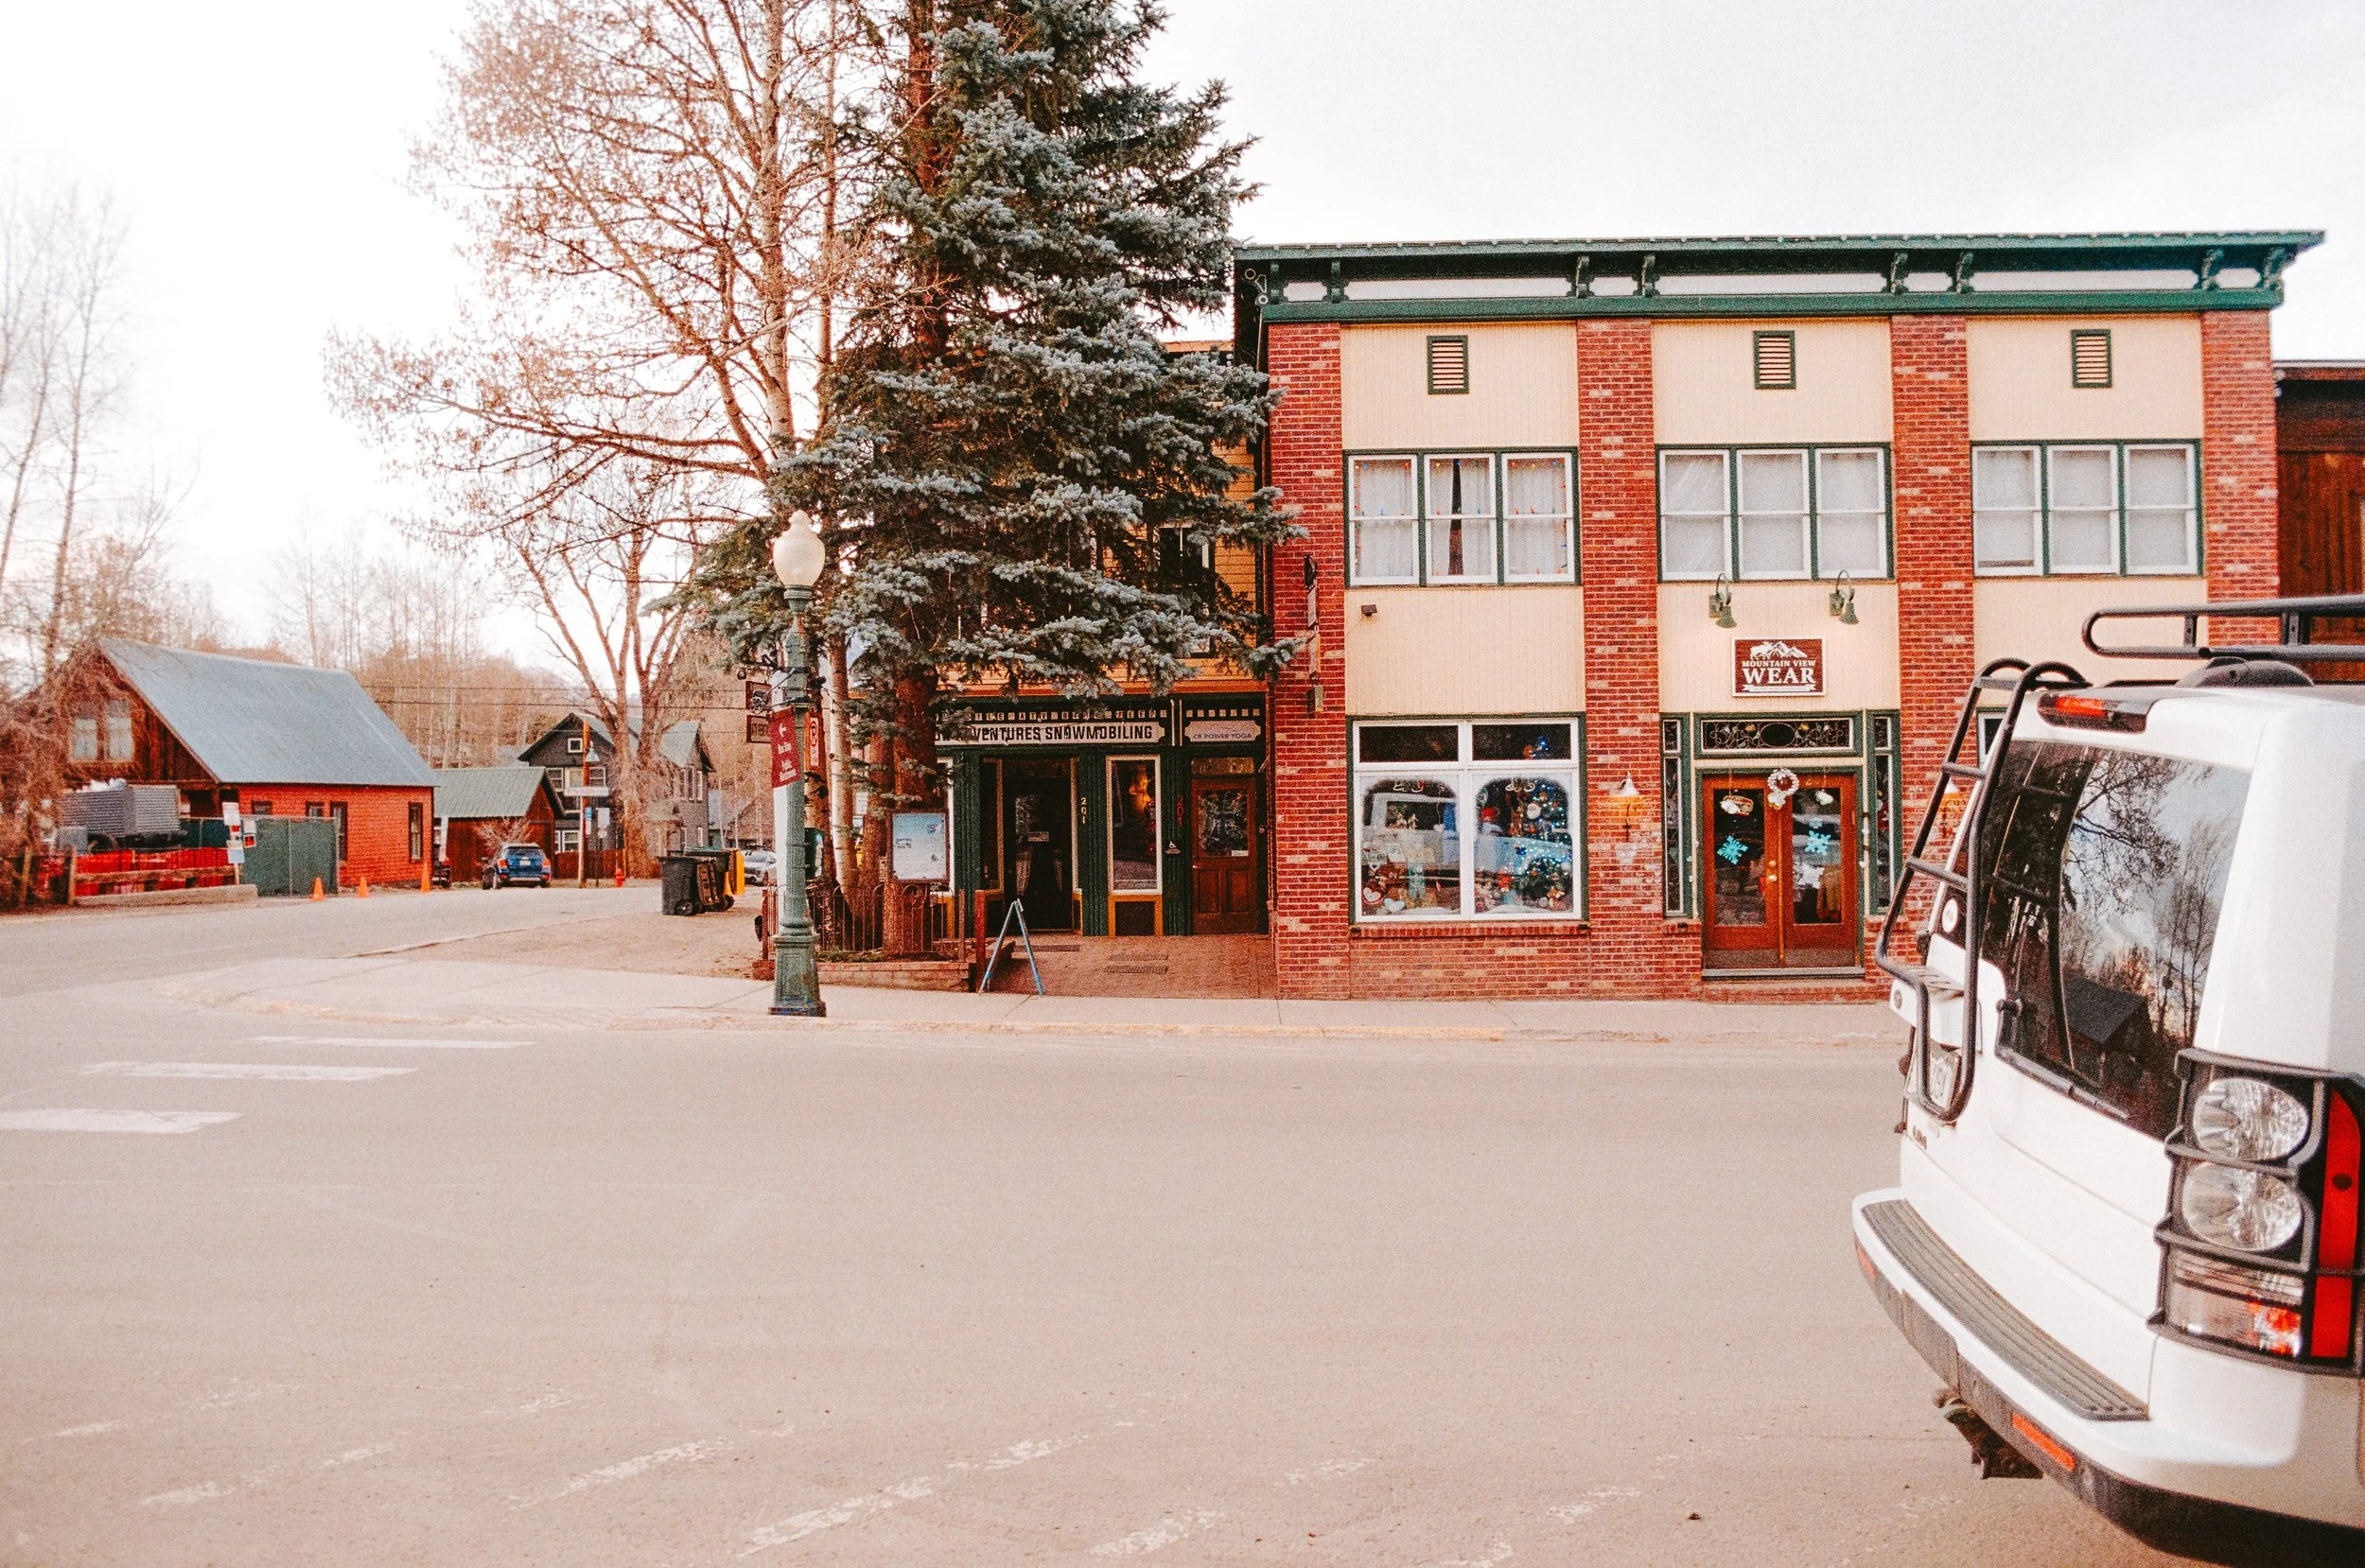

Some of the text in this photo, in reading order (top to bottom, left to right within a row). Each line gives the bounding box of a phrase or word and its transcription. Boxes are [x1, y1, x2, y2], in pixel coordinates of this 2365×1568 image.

[1742, 668, 1816, 684] WEAR
[955, 726, 1042, 742] VENTURES
[1044, 726, 1151, 740] SNOWMOBILING
